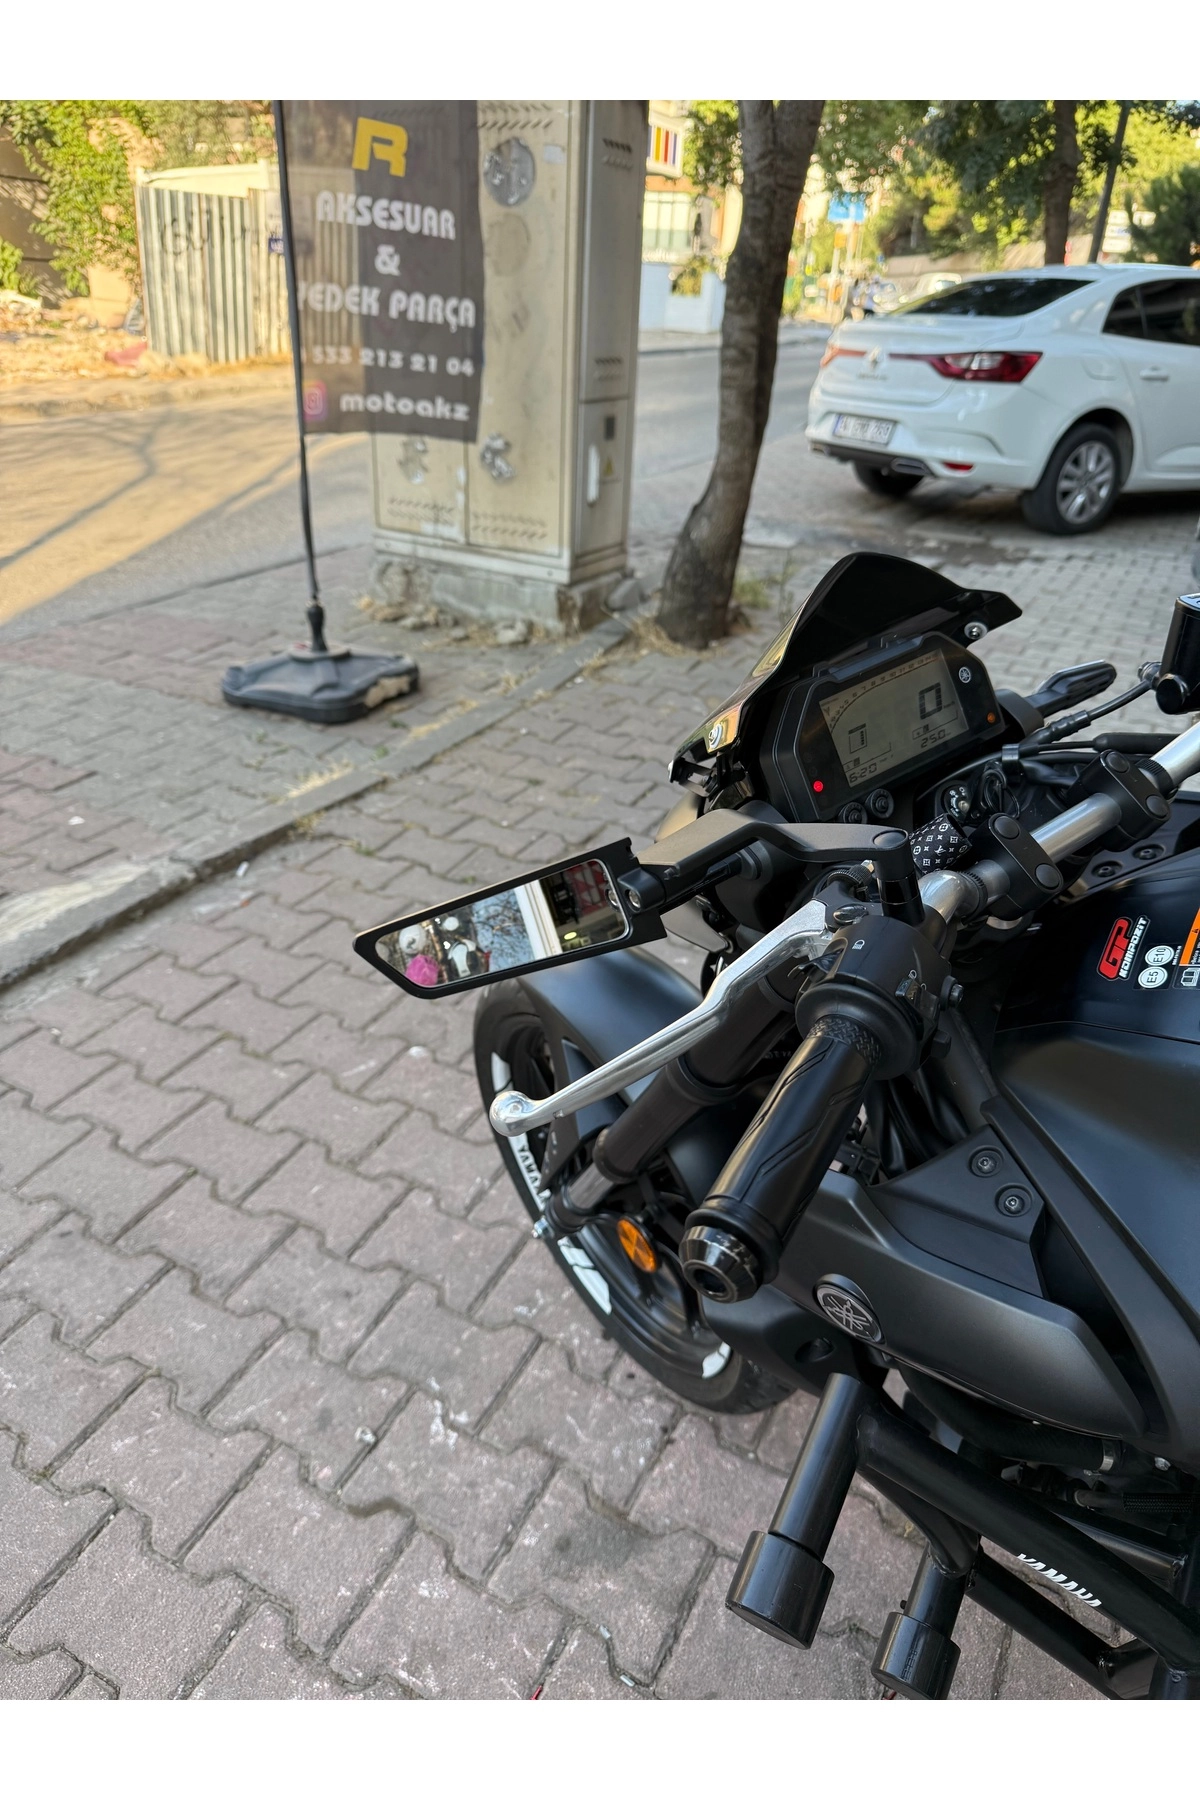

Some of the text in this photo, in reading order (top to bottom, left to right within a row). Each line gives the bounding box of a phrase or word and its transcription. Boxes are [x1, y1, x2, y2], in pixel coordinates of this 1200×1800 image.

[352, 116, 408, 177] R
[315, 189, 456, 240] AKSESUAR
[374, 243, 401, 276] &
[388, 289, 476, 333] PARÇA
[359, 347, 404, 369] 213
[410, 353, 438, 374] 21
[446, 356, 475, 377] 04
[339, 390, 470, 421] motoakz
[1146, 946, 1167, 983] E5 E10
[1016, 1553, 1102, 1608] YAMAHA
